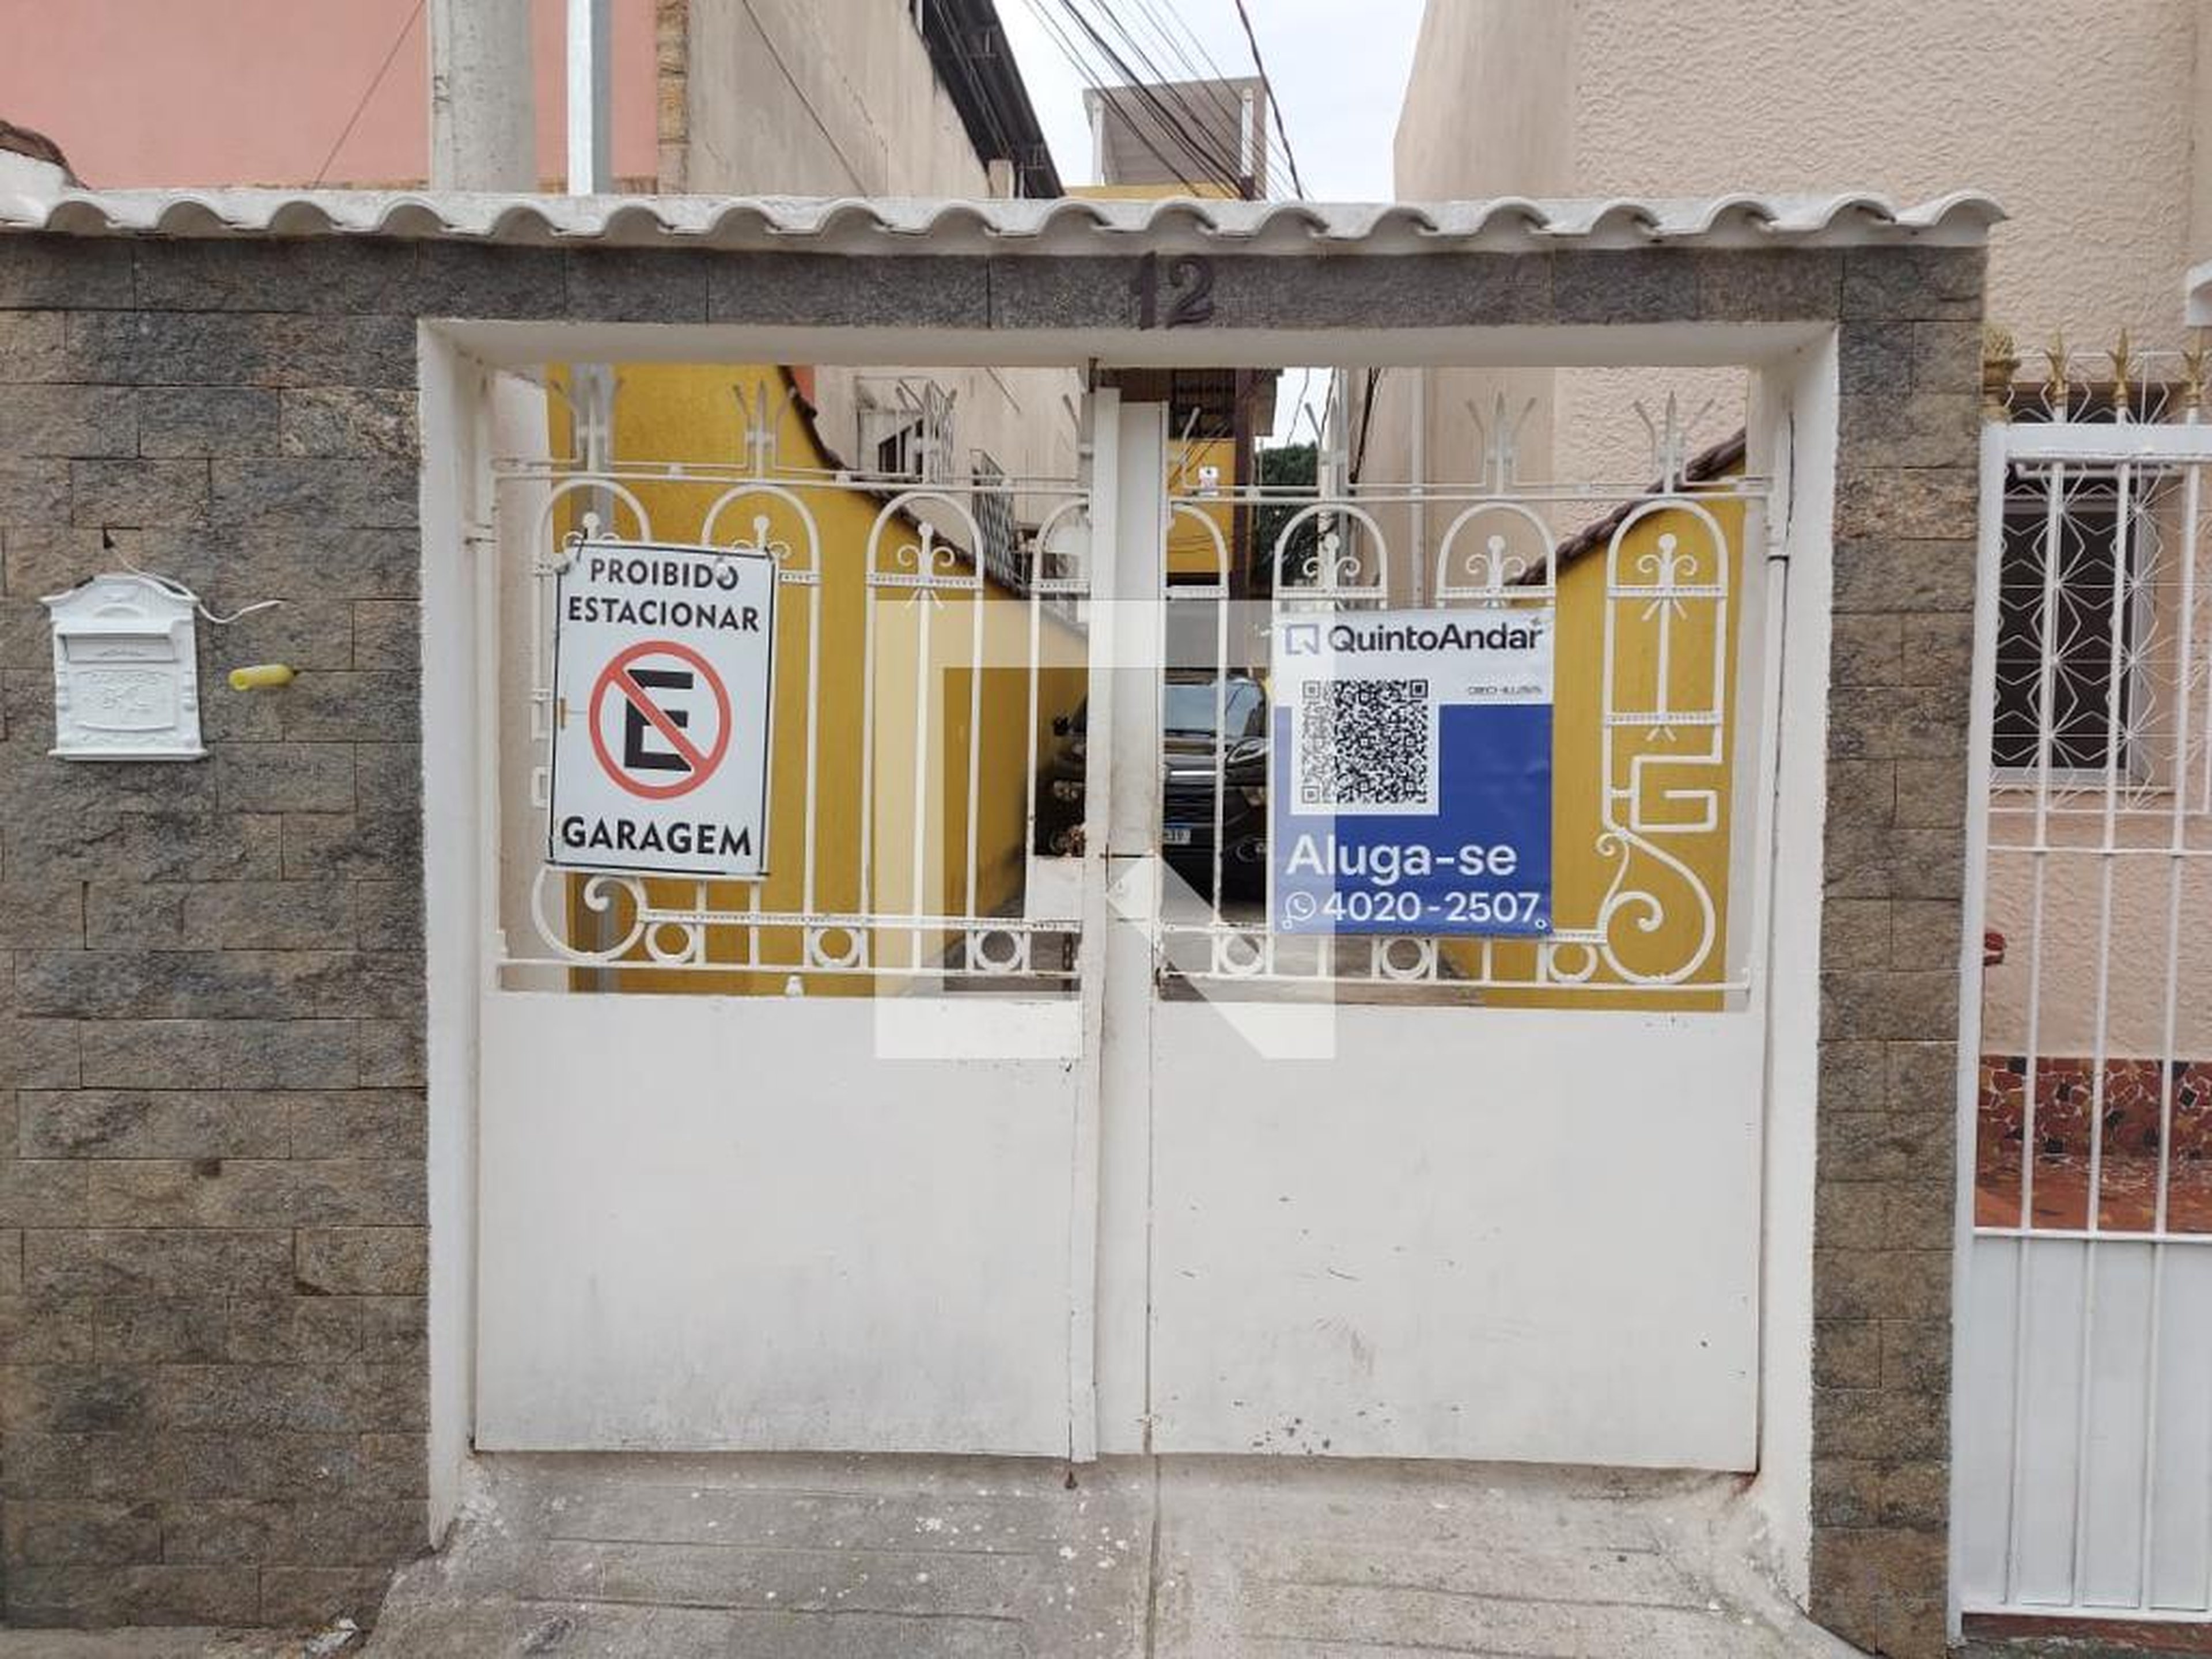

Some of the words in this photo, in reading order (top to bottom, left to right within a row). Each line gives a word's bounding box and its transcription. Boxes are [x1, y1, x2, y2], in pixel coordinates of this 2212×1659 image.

[1129, 251, 1213, 329] 12
[590, 559, 738, 590] PROIBIDO
[568, 596, 760, 632] ESTACIONAR
[1329, 623, 1543, 653] QuintoAndar
[562, 816, 751, 856] GARAGEM
[1286, 834, 1517, 886] Aluga-se
[1323, 892, 1540, 922] 4020-2507
